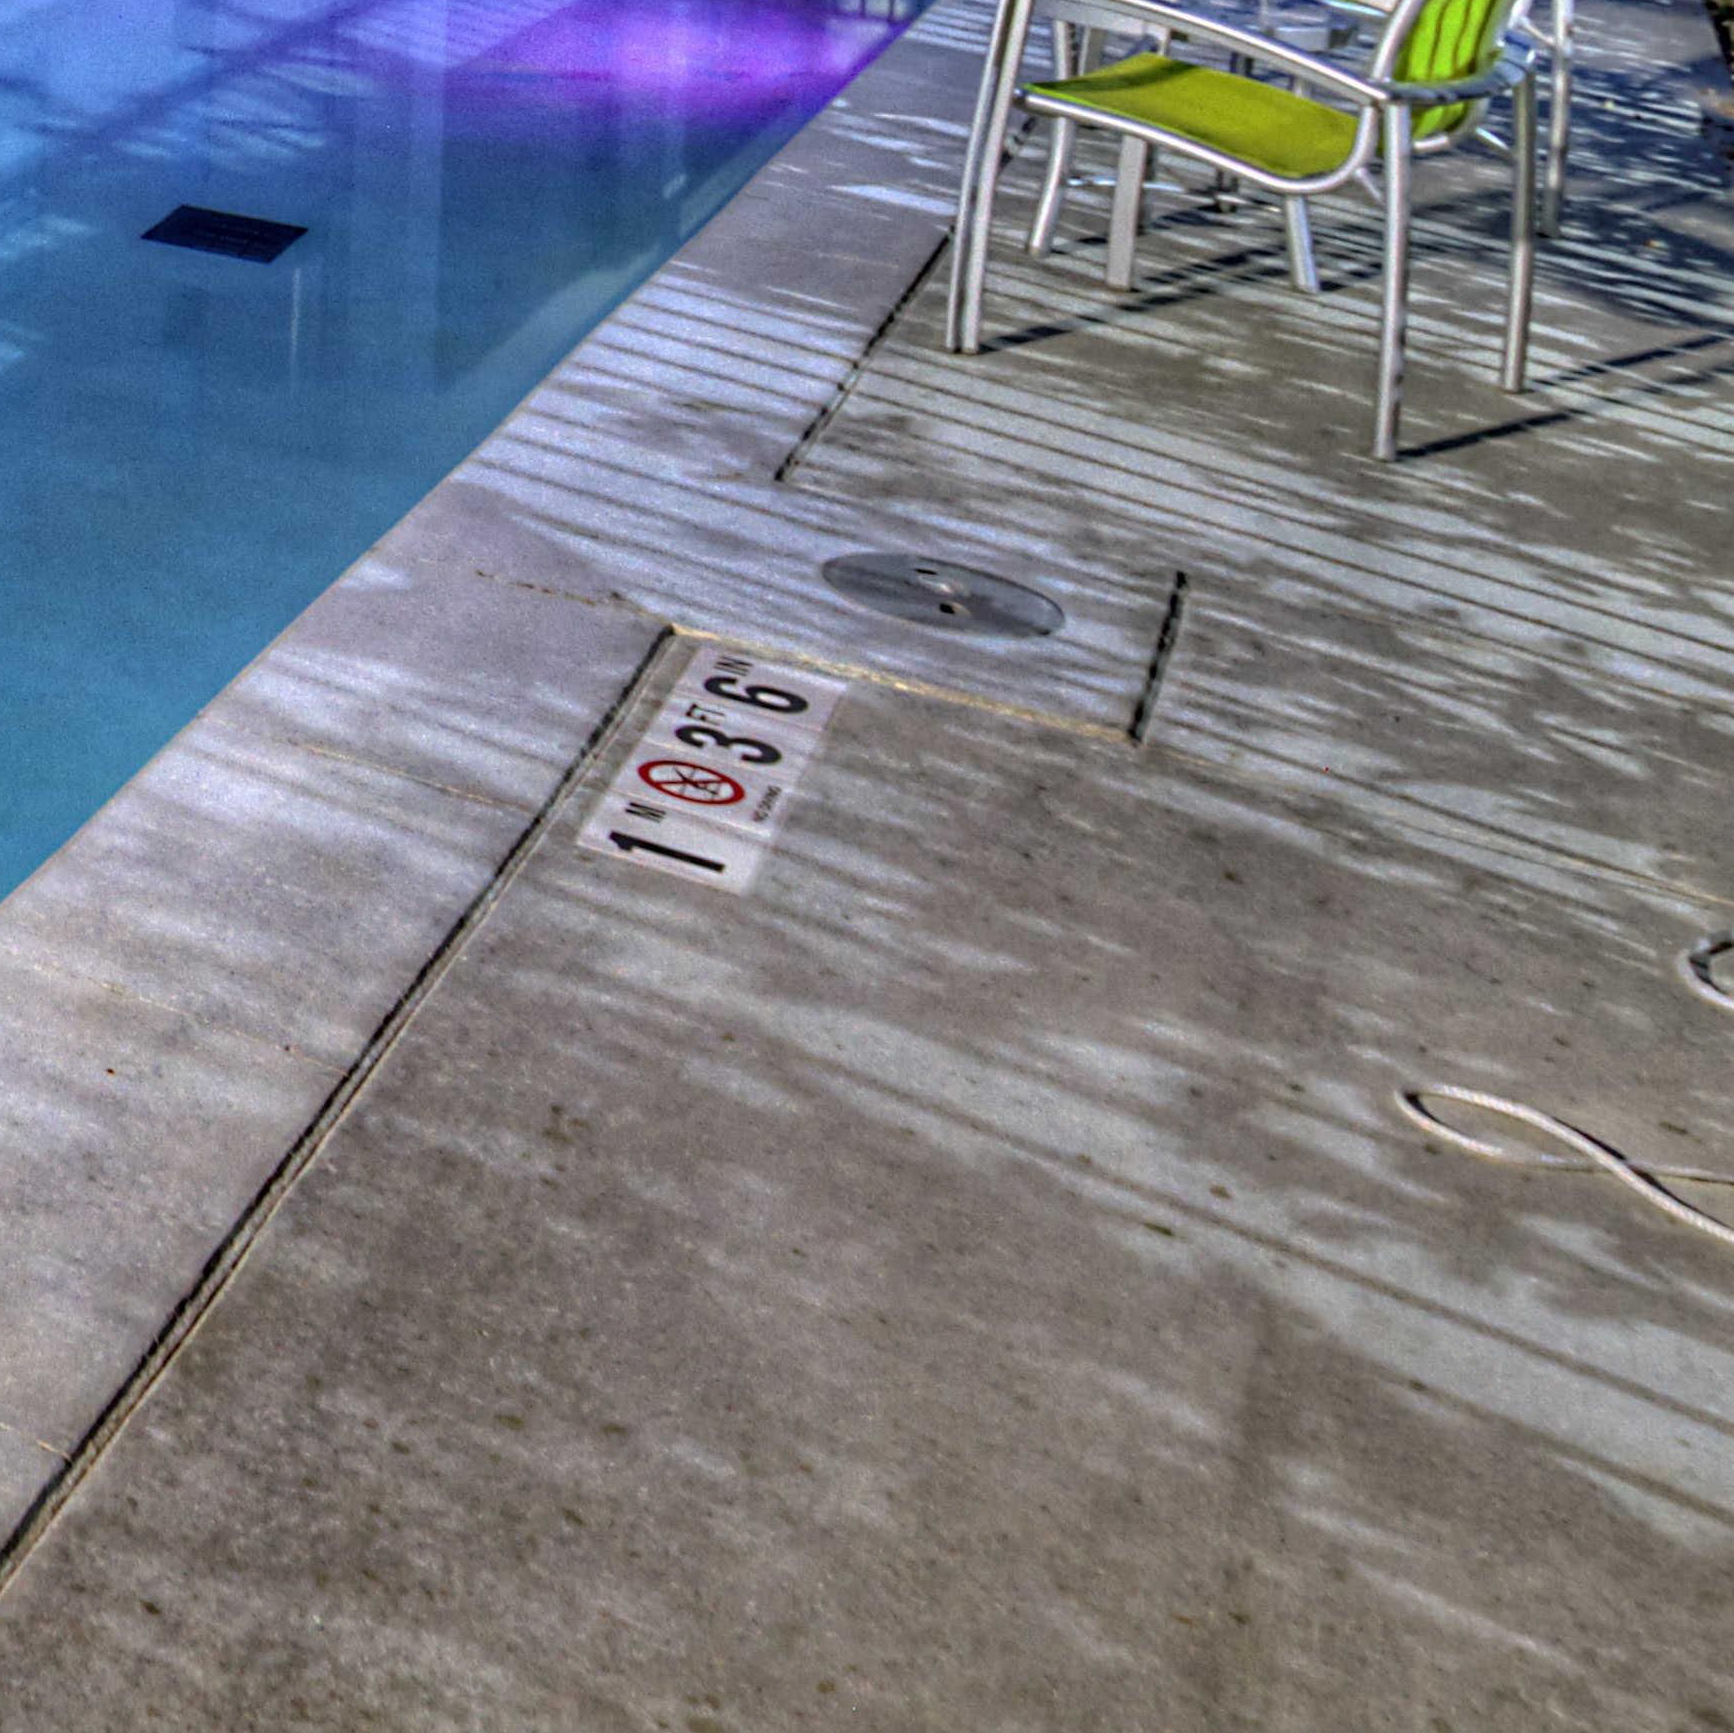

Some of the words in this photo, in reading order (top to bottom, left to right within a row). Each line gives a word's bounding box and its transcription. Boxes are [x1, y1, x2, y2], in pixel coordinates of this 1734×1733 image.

[715, 655, 754, 677] IN
[704, 676, 809, 714] 6
[686, 703, 725, 726] FT
[675, 724, 782, 765] 3
[625, 802, 666, 823] M
[609, 830, 726, 874] 1
